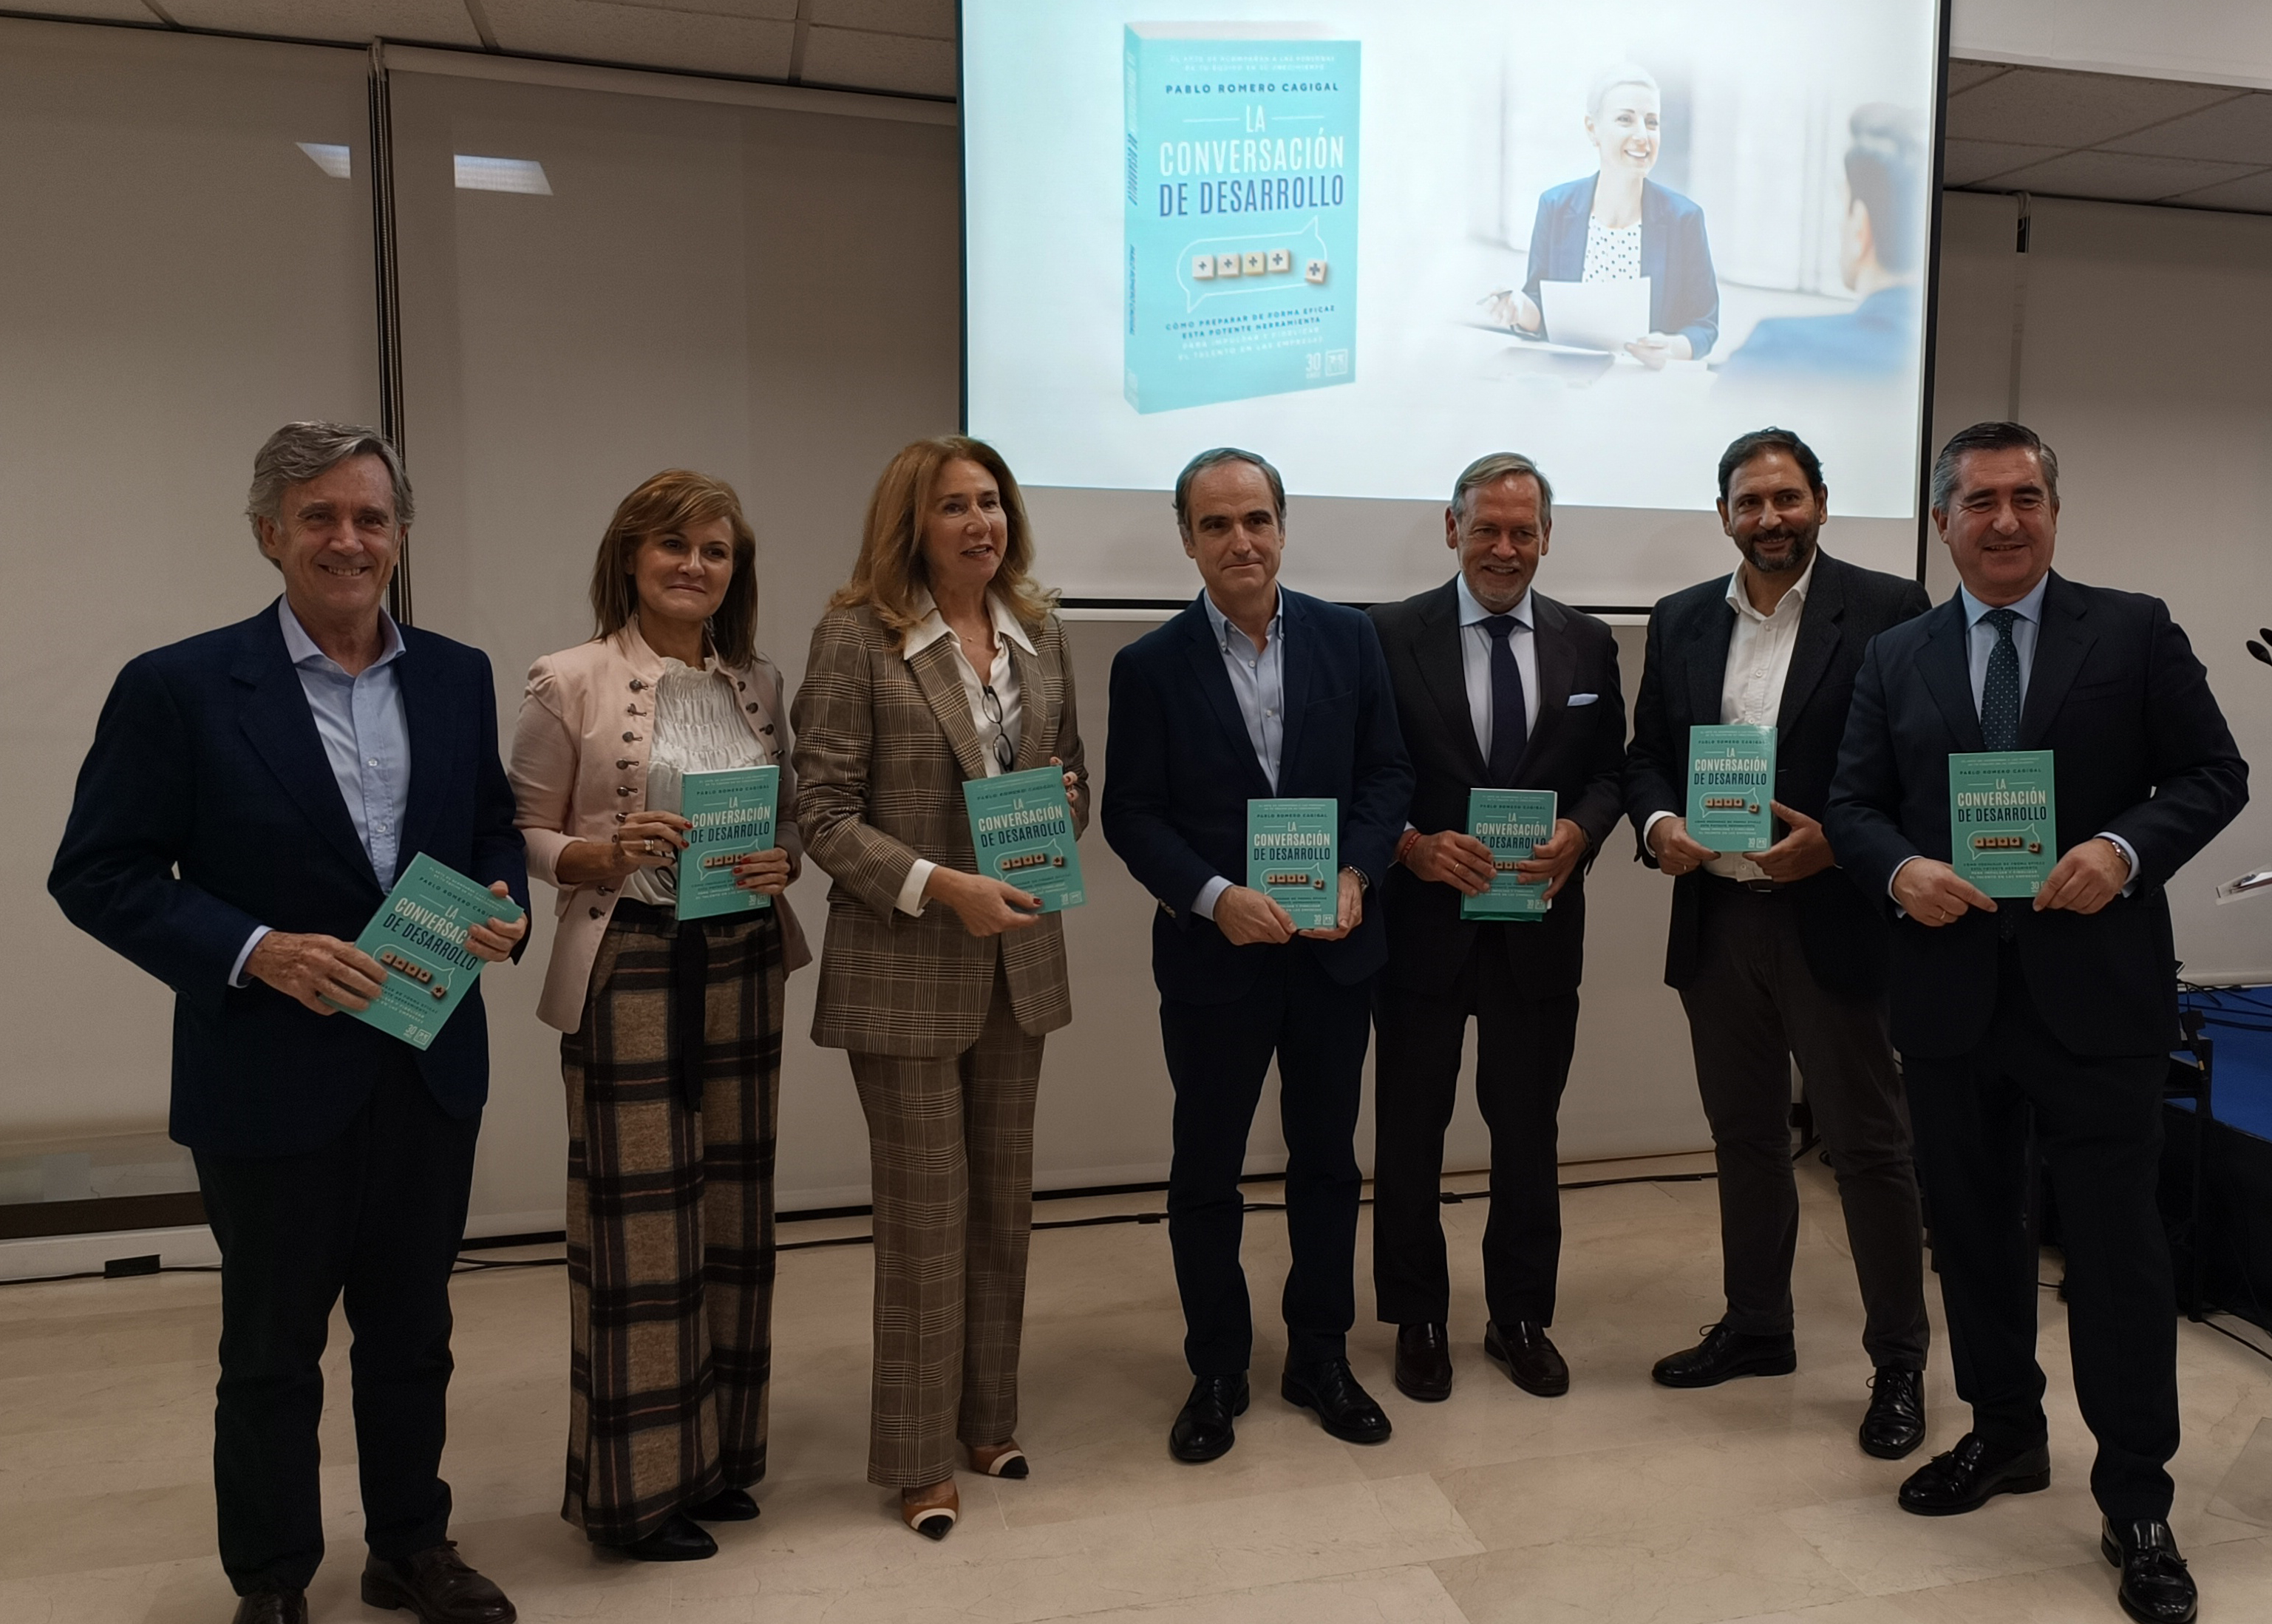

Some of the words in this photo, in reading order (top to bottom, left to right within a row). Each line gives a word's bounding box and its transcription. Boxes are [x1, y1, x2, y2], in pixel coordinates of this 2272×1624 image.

[1166, 84, 1211, 94] PABLO
[1219, 84, 1276, 93] ROMERO
[1282, 83, 1339, 92] CAGIGAL
[1246, 104, 1265, 133] LA
[1160, 127, 1344, 177] CONVERSACIÓN
[1160, 183, 1188, 217] DE
[1200, 174, 1344, 214] DESARROLLO
[1166, 320, 1194, 330] CÓMO
[1199, 315, 1248, 327] PREPARAR
[1252, 313, 1264, 322] DE
[1267, 309, 1300, 319] FORMA
[1208, 325, 1251, 336] POTENTE
[1305, 353, 1322, 372] 30
[1727, 747, 1735, 758] LA
[1695, 756, 1767, 771] CONVERSACIÓN
[1694, 773, 1704, 785] DE
[1709, 773, 1767, 785] DESARROLLO
[1996, 778, 2007, 790] LA
[729, 796, 738, 809] LA
[1013, 798, 1024, 810] LA
[1958, 786, 2047, 806] CONVERSACIÓN
[692, 803, 771, 828] CONVERSACIÓN
[978, 801, 1064, 832] CONVERSACIÓN
[1508, 812, 1516, 822] LA
[1958, 809, 1971, 822] DE
[1976, 806, 2047, 821] DESARROLLO
[691, 829, 704, 843] DE
[708, 821, 770, 842] DESARROLLO
[981, 833, 994, 848] DE
[998, 821, 1066, 845] DESARROLLO
[1288, 821, 1296, 832] LA
[1476, 821, 1547, 836] CONVERSACIÓN
[1254, 830, 1330, 846] CONVERSACIÓN
[1254, 848, 1265, 860] DE
[1269, 847, 1330, 860] DESARROLLO
[419, 876, 441, 891] PABLO
[443, 889, 471, 907] ROMERO
[473, 906, 493, 917] CAGI
[444, 904, 458, 920] LA
[394, 897, 470, 945] CONVERSAC
[382, 913, 404, 933] DE
[401, 923, 478, 971] DESARROLLO
[405, 1024, 418, 1035] 30
